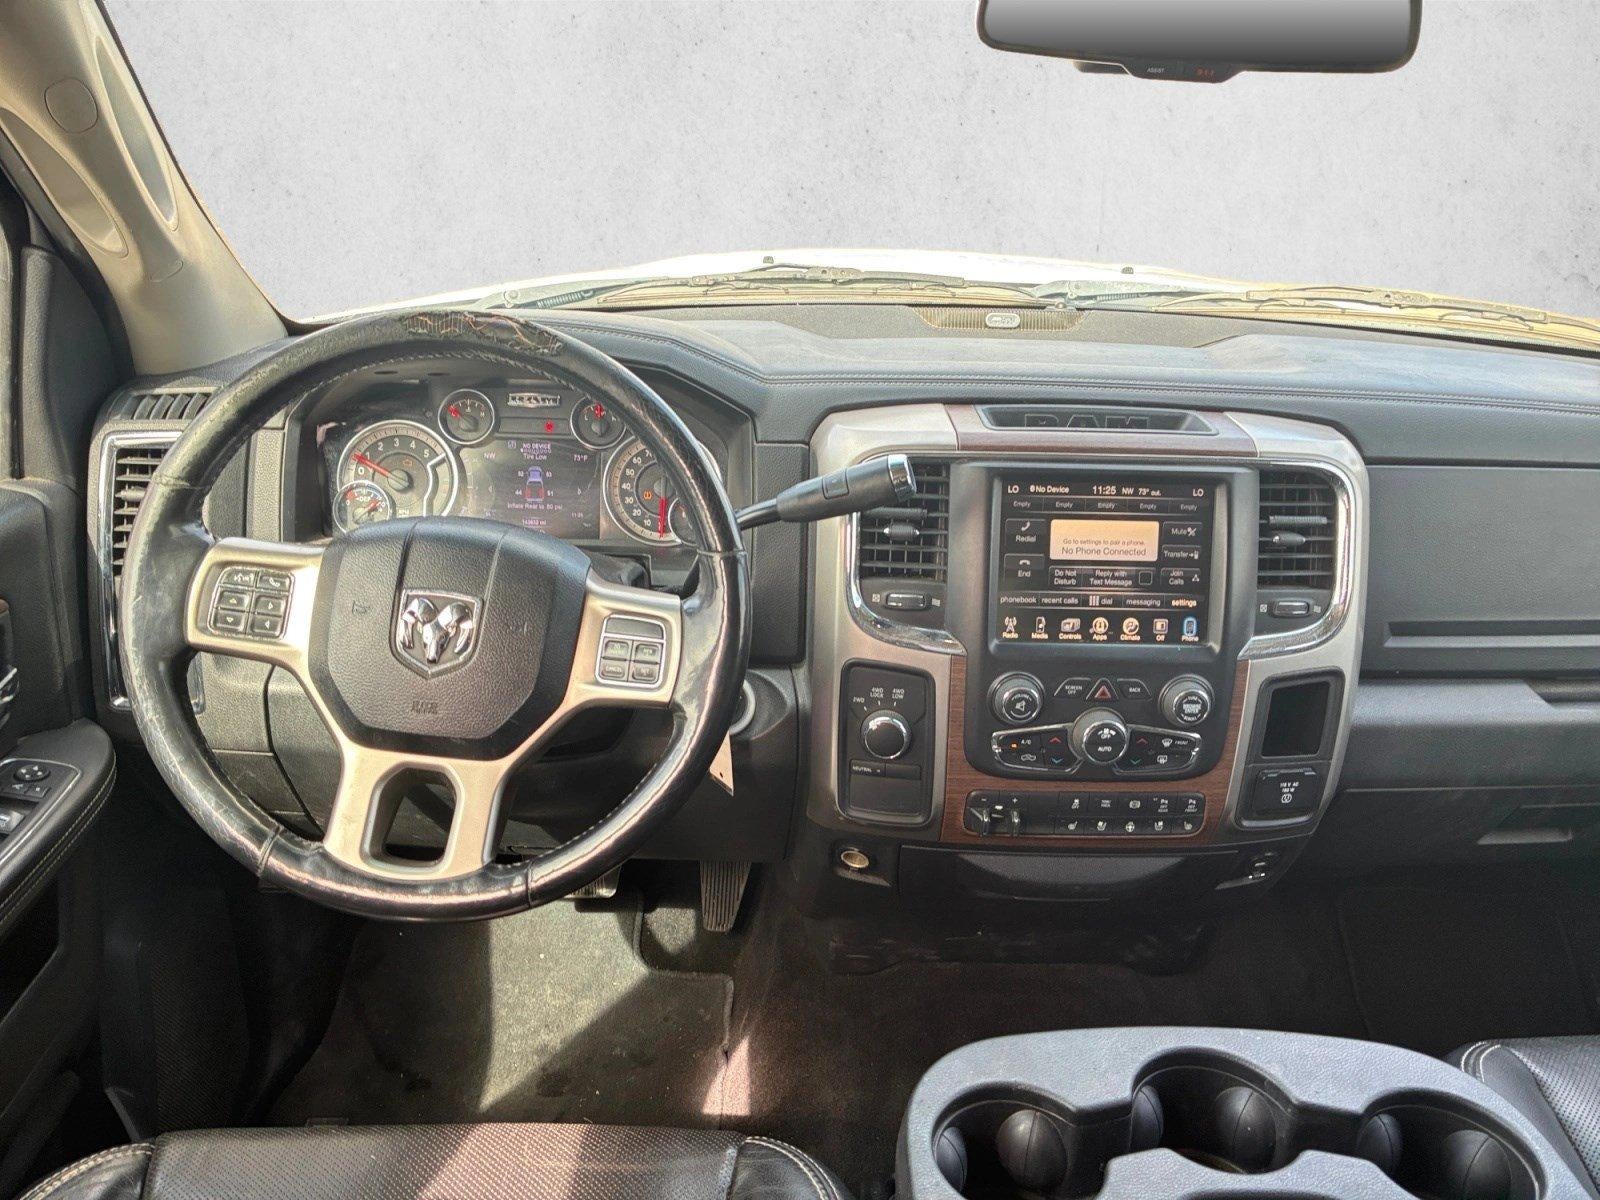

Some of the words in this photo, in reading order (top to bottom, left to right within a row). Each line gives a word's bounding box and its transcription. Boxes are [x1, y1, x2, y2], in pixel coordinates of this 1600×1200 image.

[378, 442, 384, 451] 2
[394, 438, 400, 447] 3
[410, 441, 416, 449] 4
[424, 450, 430, 458] 5
[632, 457, 642, 465] 60
[358, 467, 365, 475] 0
[1007, 485, 1020, 494] LO
[1035, 485, 1046, 493] No
[1047, 485, 1070, 494] Device
[1092, 485, 1117, 495] 11:25
[1122, 487, 1134, 495] NW
[1192, 488, 1204, 497] LO
[643, 519, 652, 527] 10
[1171, 528, 1187, 536] Mute
[1015, 535, 1036, 543] Redial
[1061, 546, 1074, 554] No
[1075, 547, 1101, 555] Phone
[1103, 547, 1147, 556] Connected
[1163, 550, 1189, 558] Transfer
[1018, 570, 1031, 578] End
[1065, 569, 1077, 577] Not
[1054, 577, 1077, 585] Disturb
[1089, 578, 1103, 586] Text
[1104, 578, 1132, 587] Message
[1168, 577, 1184, 585] Calls
[1000, 596, 1037, 604] phonebook
[1041, 596, 1062, 604] recent
[1063, 597, 1079, 605] calls
[1125, 598, 1161, 607] messaging
[1171, 598, 1197, 607] settings
[1002, 631, 1019, 639] Radio
[1031, 632, 1049, 640] Media
[1058, 632, 1082, 640] Controls
[1181, 634, 1199, 642] Phone
